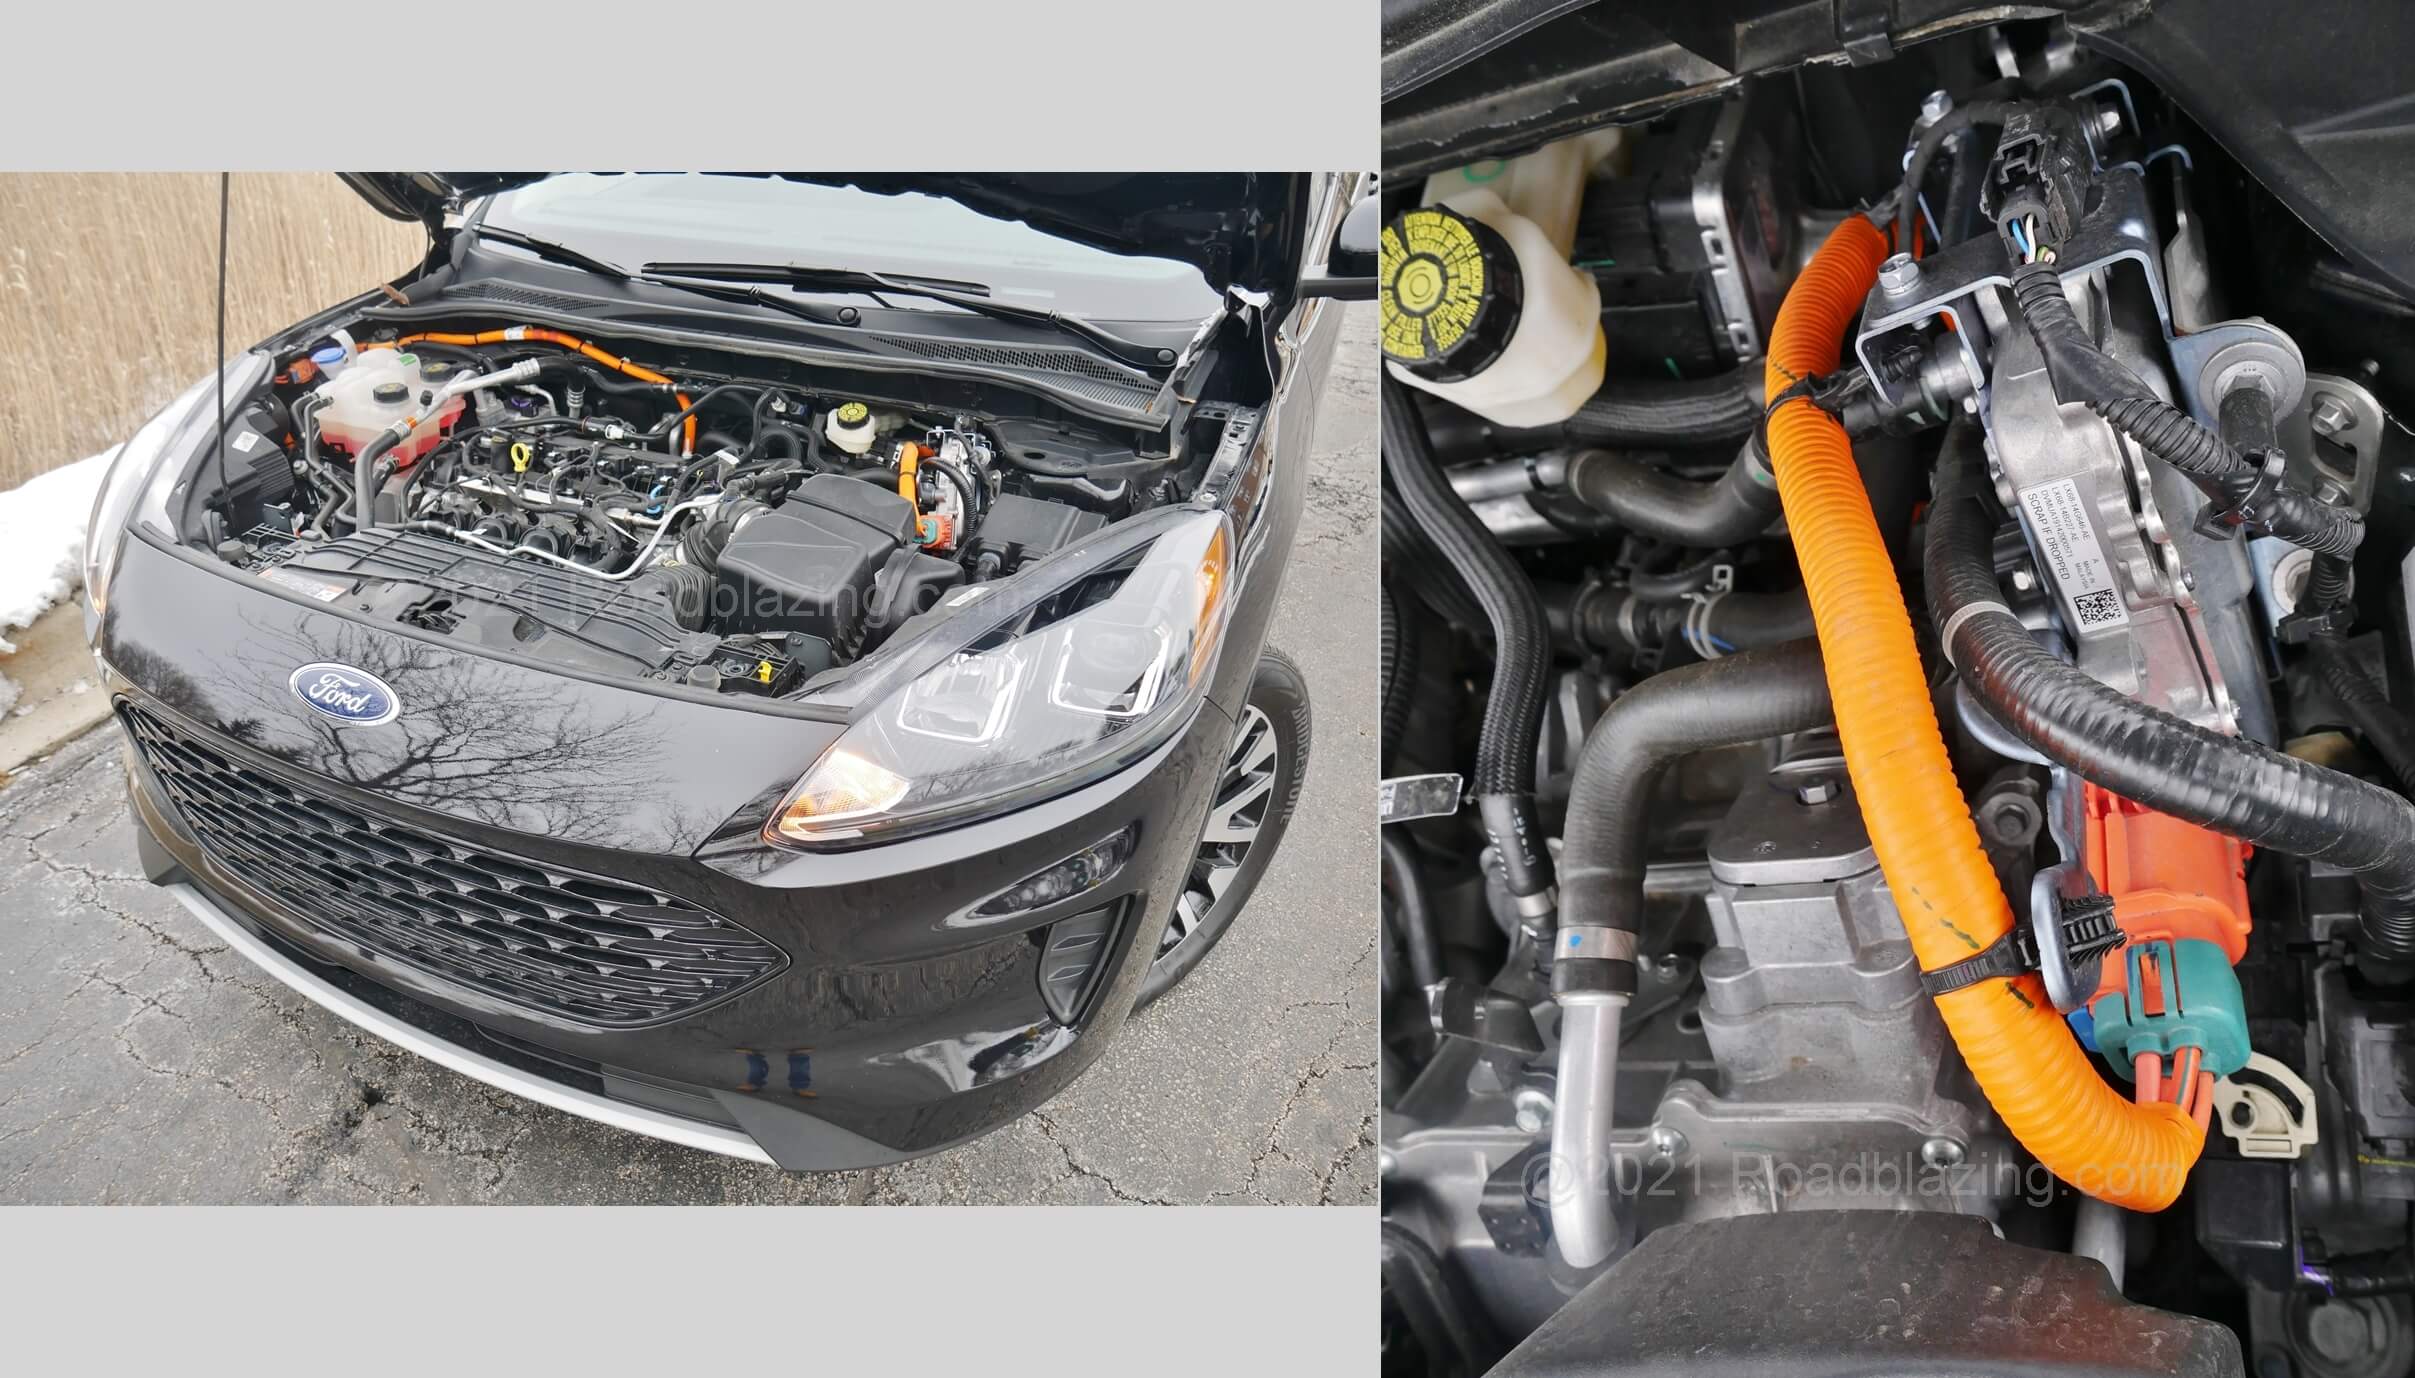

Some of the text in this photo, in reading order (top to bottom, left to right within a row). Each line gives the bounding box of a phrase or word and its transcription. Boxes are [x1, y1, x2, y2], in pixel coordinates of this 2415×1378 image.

[2027, 493, 2070, 580] SCRAP IF DROPPED
[308, 673, 372, 713] Ford
